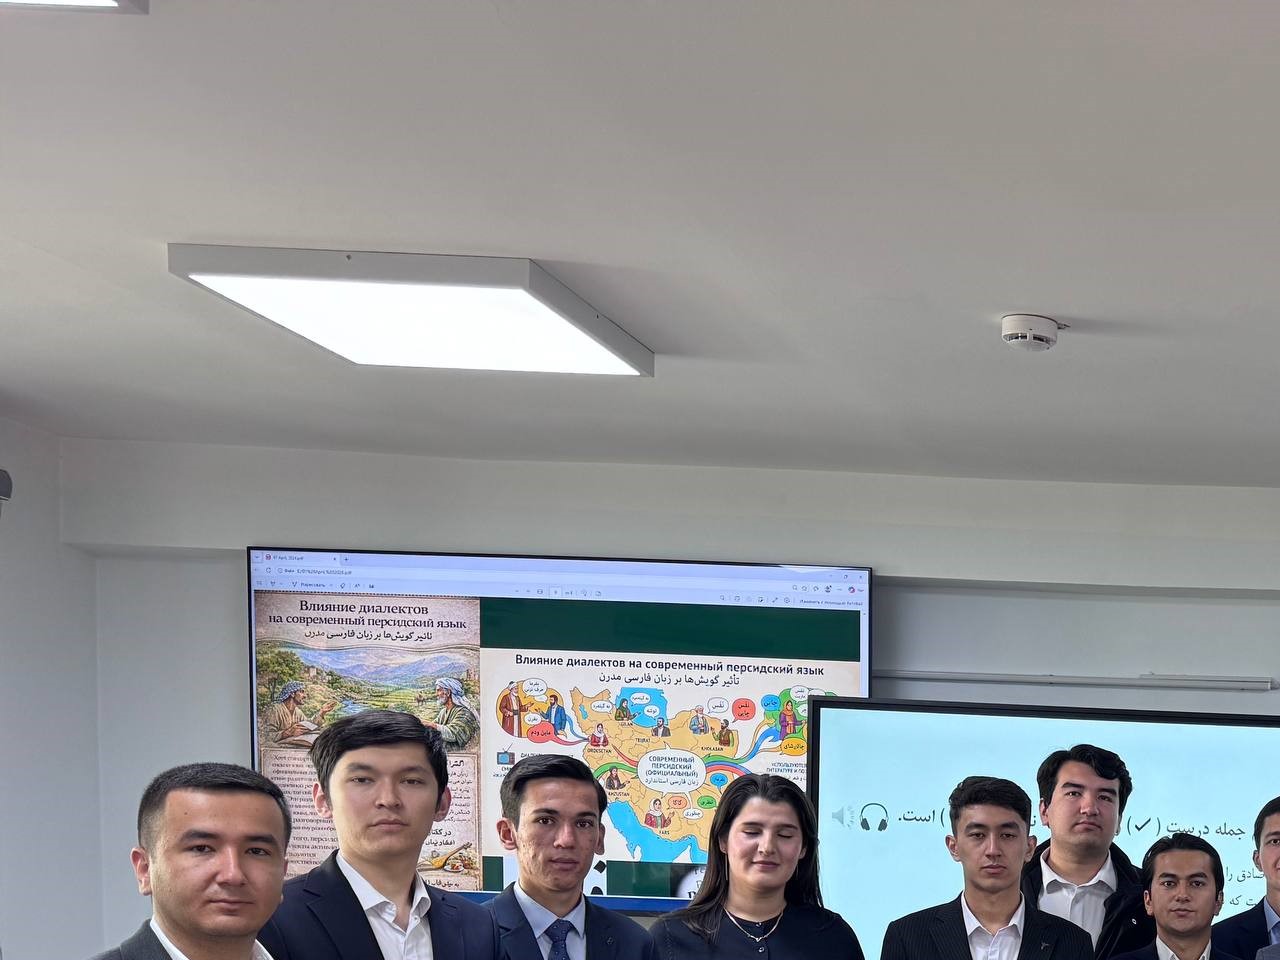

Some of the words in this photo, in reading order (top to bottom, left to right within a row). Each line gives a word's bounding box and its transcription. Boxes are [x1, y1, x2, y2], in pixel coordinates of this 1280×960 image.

[300, 600, 356, 613] Влияние
[358, 604, 429, 615] диалектов
[269, 615, 283, 623] на
[286, 615, 365, 626] современный
[367, 618, 434, 628] персидский
[437, 620, 467, 629] язык
[326, 629, 355, 639] فارسی
[515, 654, 564, 665] Влияние
[566, 657, 626, 668] диалектов
[628, 660, 642, 668] на
[645, 660, 723, 672] современный
[726, 662, 793, 675] персидский
[796, 666, 824, 676] язык
[599, 672, 622, 682] مدرن
[624, 672, 651, 683] فارسی
[654, 674, 672, 685] زبان
[674, 677, 682, 685] بر
[1216, 822, 1246, 840] جمله
